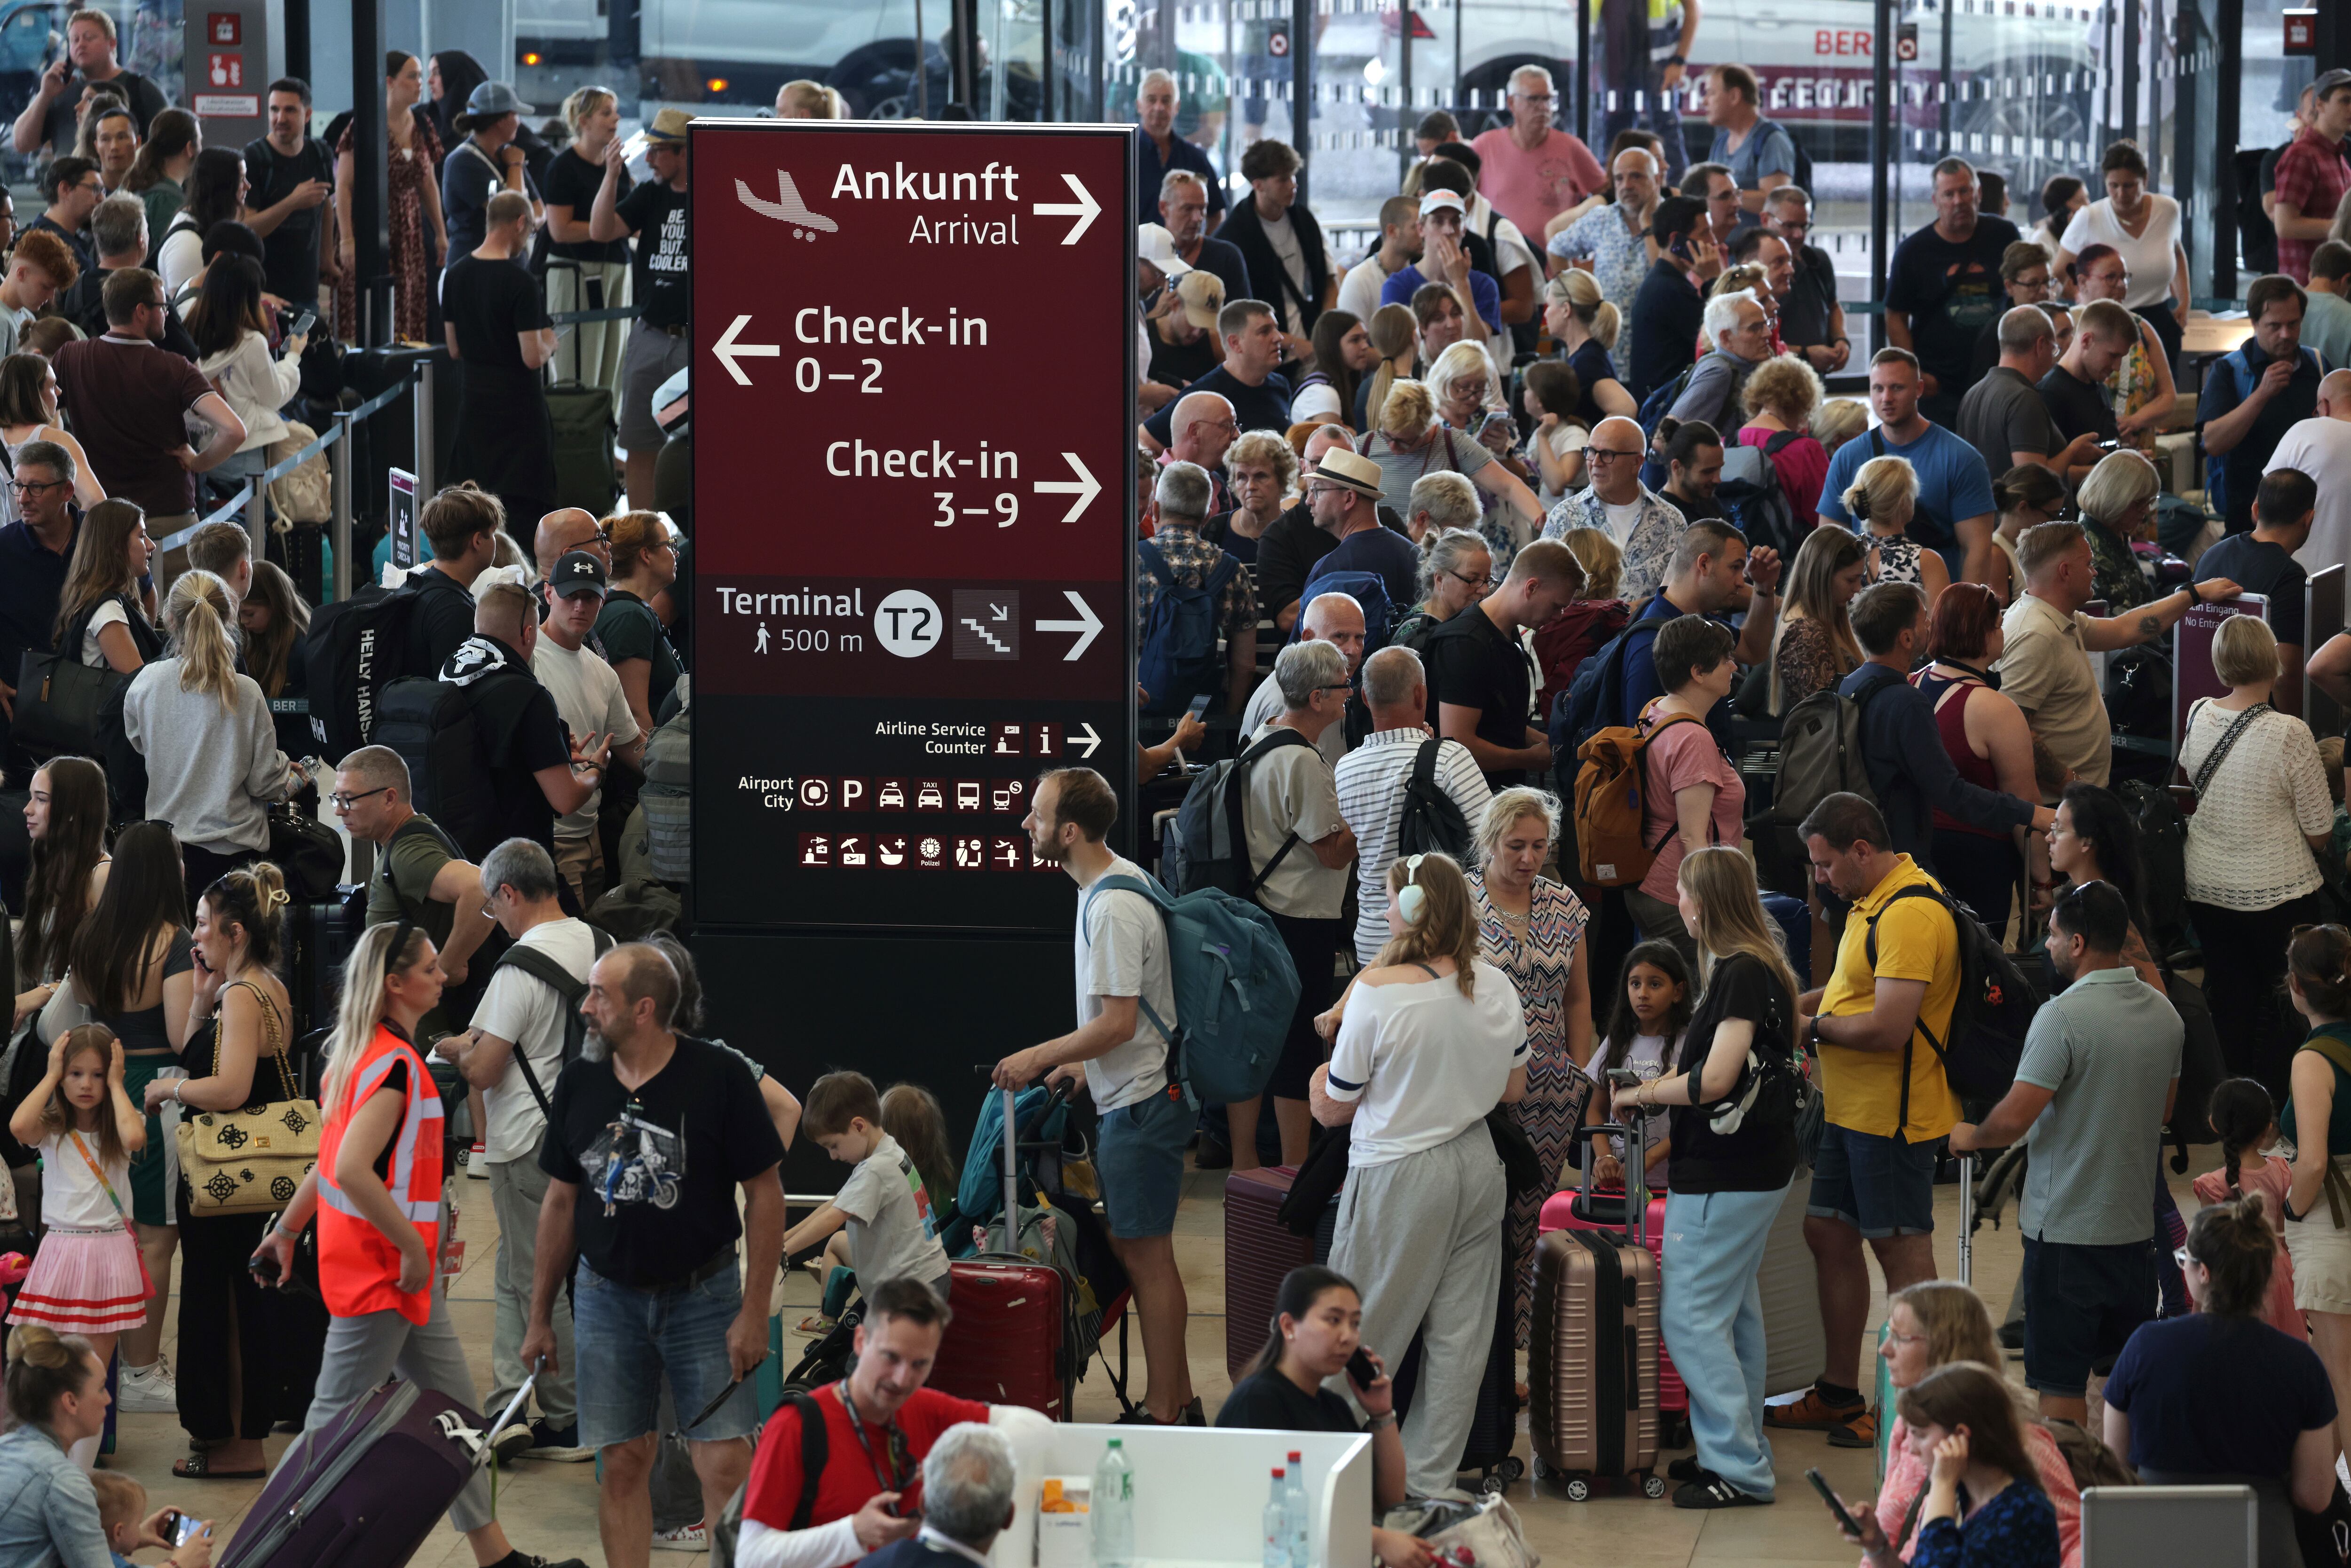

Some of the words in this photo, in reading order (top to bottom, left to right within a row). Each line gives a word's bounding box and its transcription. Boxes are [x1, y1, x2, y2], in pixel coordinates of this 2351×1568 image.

[1815, 30, 1872, 55] BER
[831, 161, 1019, 201] Ankunft
[661, 223, 686, 240] YOU.
[909, 213, 1019, 245] Arrival
[659, 239, 683, 255] BUT.
[796, 306, 987, 346] Check-in
[827, 439, 1018, 479] Check-in
[397, 540, 410, 553] PRIORITY
[397, 551, 410, 564] CHECK-IN
[717, 587, 864, 616] Terminal
[2206, 603, 2239, 616] Eingang
[884, 607, 931, 641] T2
[2185, 617, 2196, 626] No
[2199, 618, 2222, 629] Entra
[782, 629, 829, 652] 500
[841, 635, 862, 652] m
[359, 629, 374, 680] HELLY
[273, 701, 296, 711] BER
[875, 721, 926, 735] Airline
[931, 722, 986, 736] Service
[925, 741, 986, 754] Counter
[2111, 734, 2127, 747] BER
[738, 776, 794, 793] Airport
[844, 780, 863, 807] P
[764, 794, 794, 812] City
